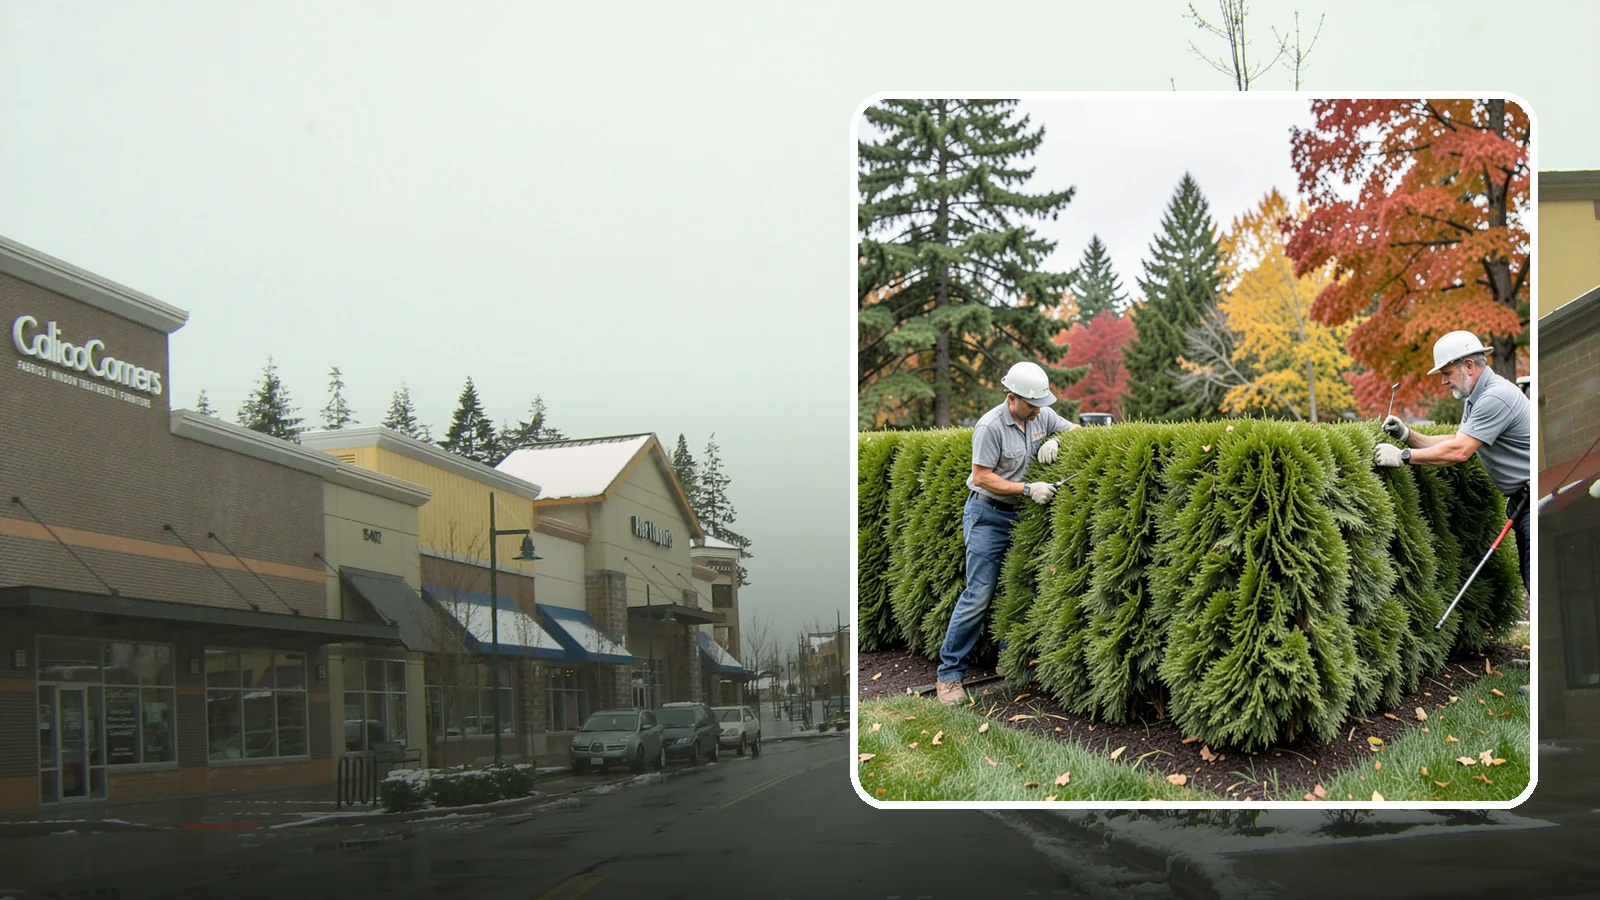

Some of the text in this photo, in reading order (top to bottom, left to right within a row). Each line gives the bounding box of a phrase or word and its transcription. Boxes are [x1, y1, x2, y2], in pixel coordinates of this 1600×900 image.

[17, 360, 47, 377] FABRICS
[51, 370, 78, 386] WINDOW
[78, 378, 116, 398] TREATMENTS
